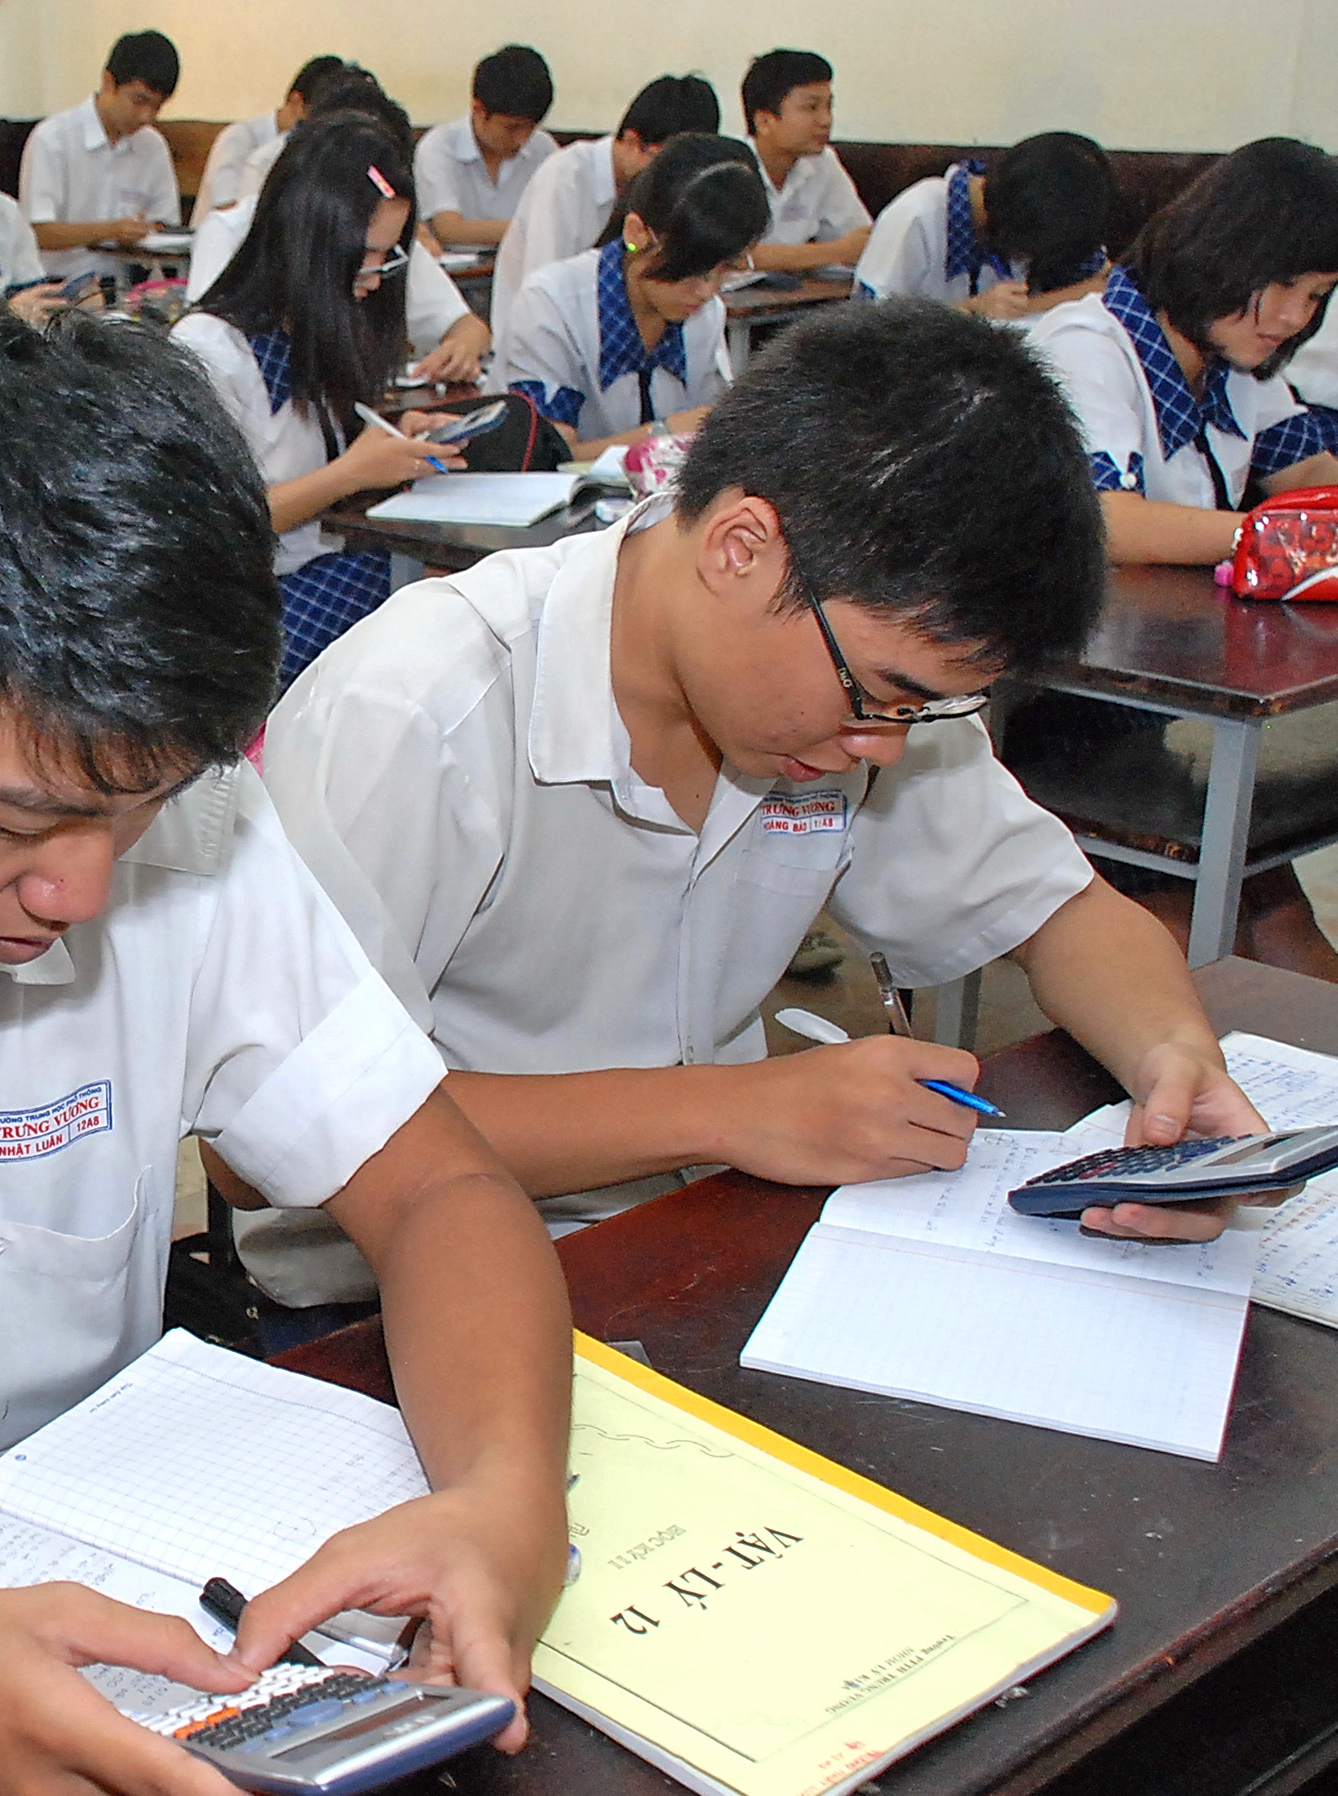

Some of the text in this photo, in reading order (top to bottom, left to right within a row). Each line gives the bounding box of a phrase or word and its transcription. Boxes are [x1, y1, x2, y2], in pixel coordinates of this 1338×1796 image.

[54, 1096, 100, 1127] VƯƠNG
[76, 1116, 100, 1132] 12A8
[36, 1133, 63, 1152] LUÂN
[609, 1604, 660, 1635] 12
